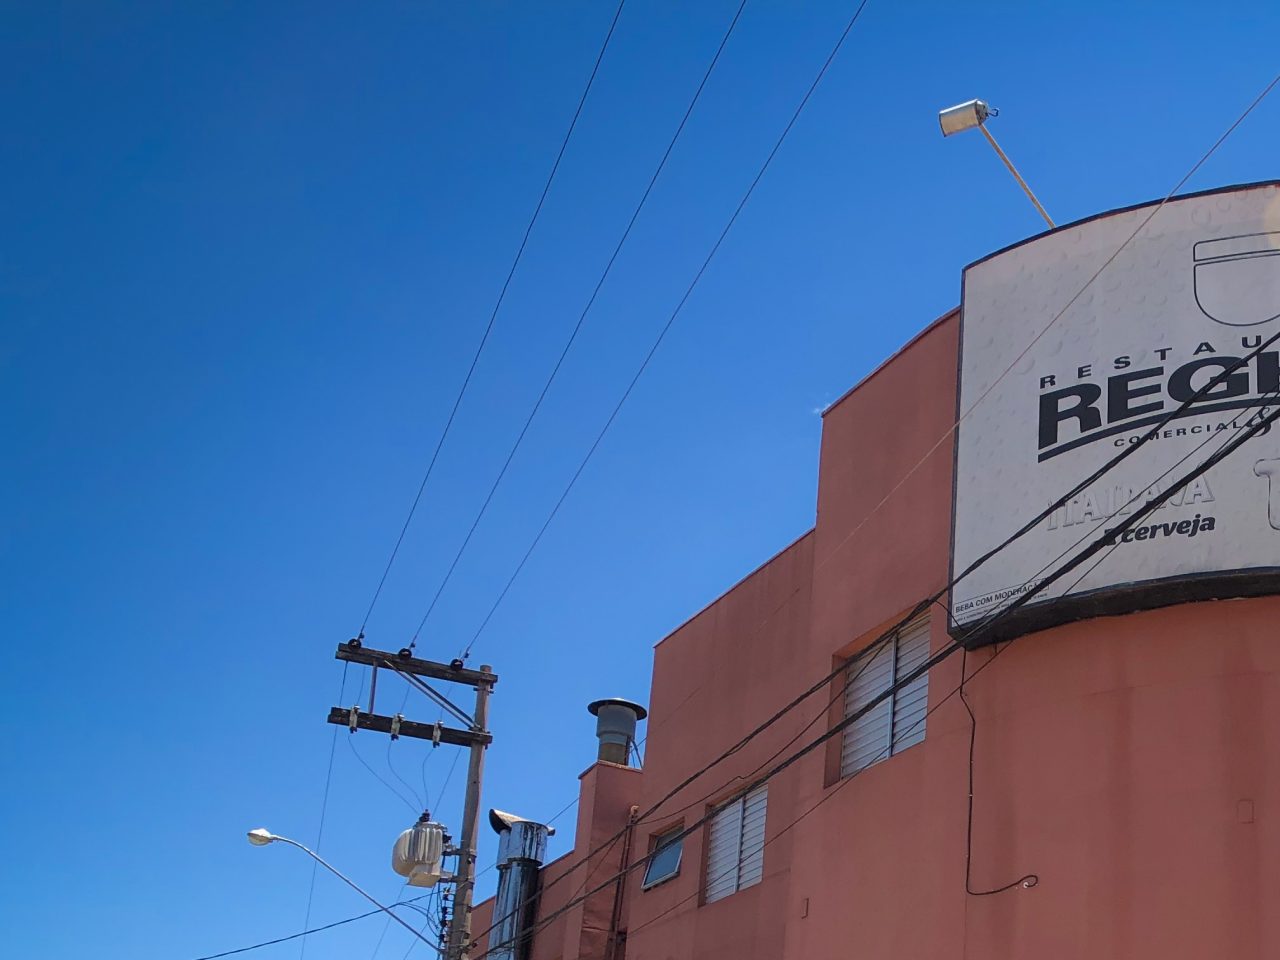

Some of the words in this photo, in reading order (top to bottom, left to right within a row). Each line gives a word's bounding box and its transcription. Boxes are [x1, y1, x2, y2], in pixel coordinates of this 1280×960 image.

[1114, 421, 1242, 447] COMERCIAL
[1121, 514, 1216, 543] cerveja
[955, 601, 974, 613] BEBA
[975, 596, 993, 606] COM
